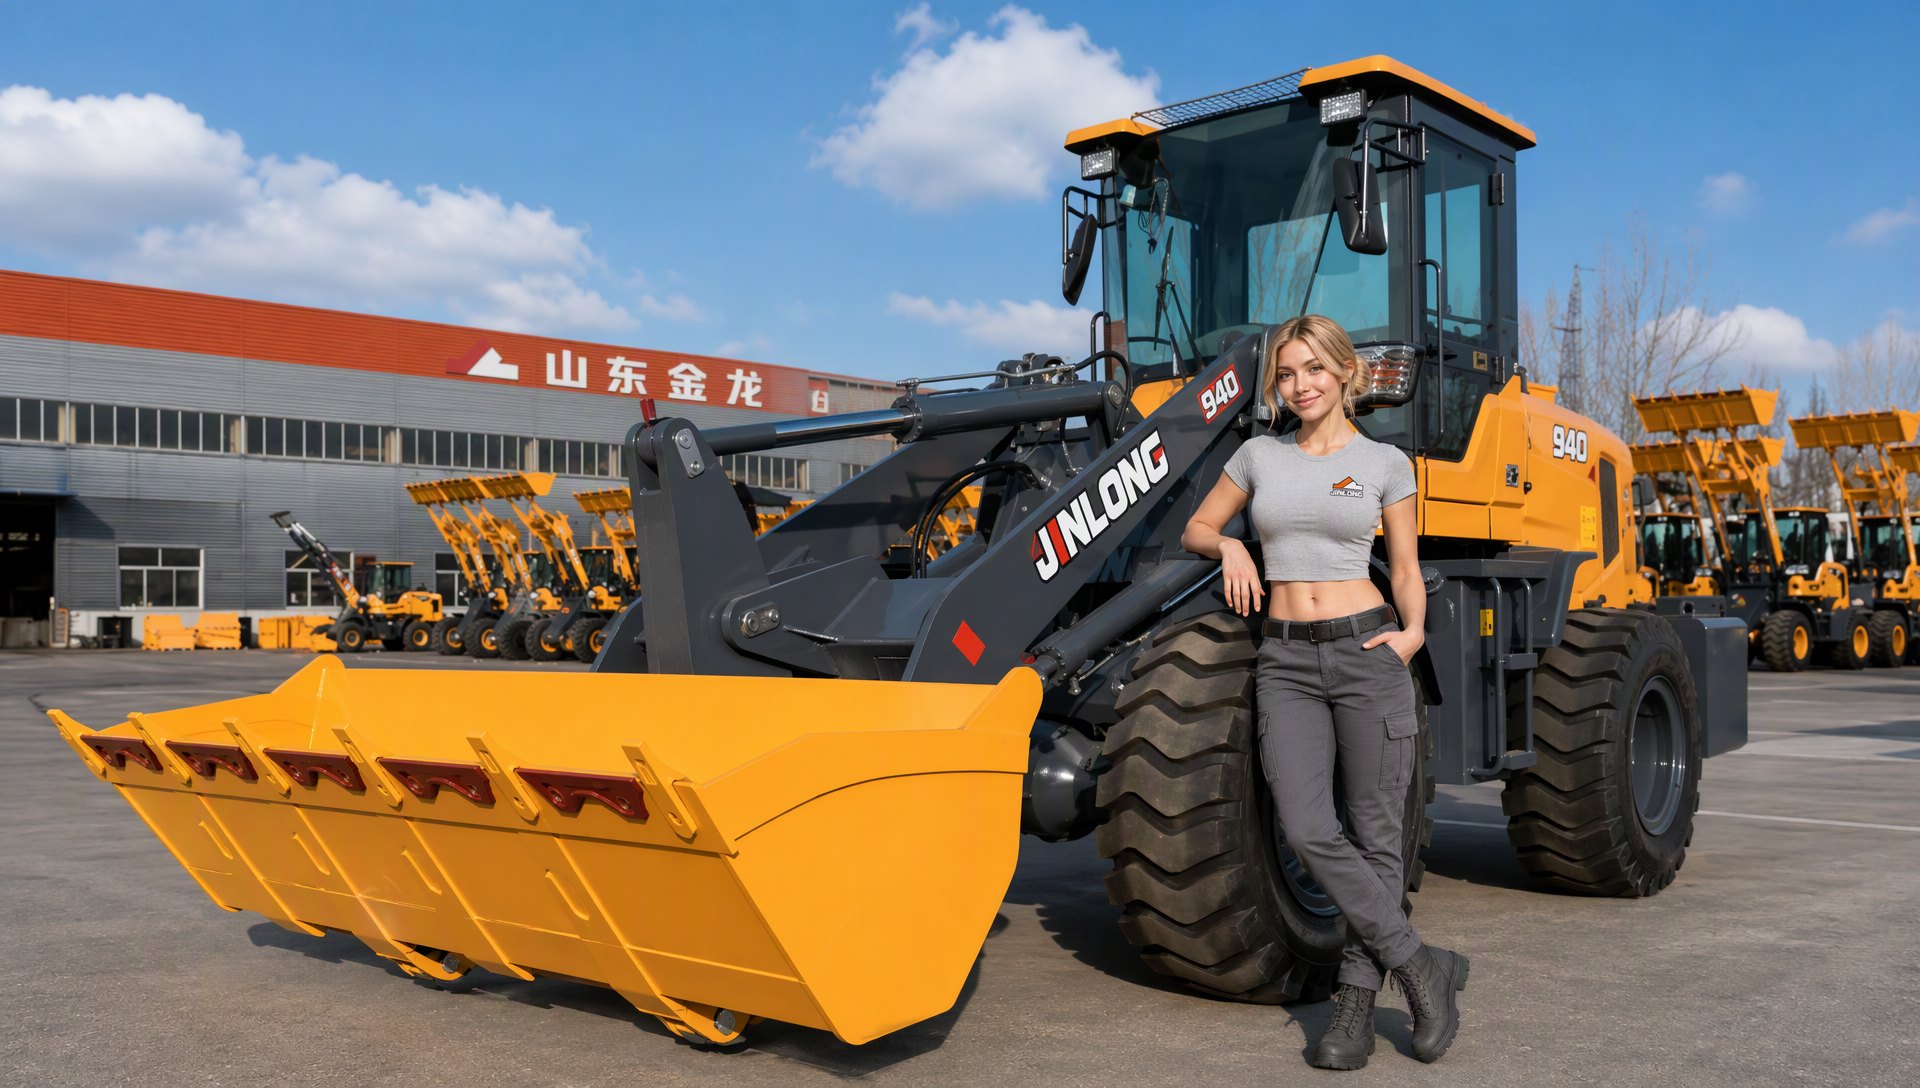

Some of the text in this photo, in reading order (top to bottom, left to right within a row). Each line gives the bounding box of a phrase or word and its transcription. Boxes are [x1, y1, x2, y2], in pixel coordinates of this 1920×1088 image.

[546, 349, 763, 408] 山东金龙
[1201, 369, 1240, 420] 940
[1553, 424, 1587, 463] 940
[1034, 429, 1170, 581] JINLONG
